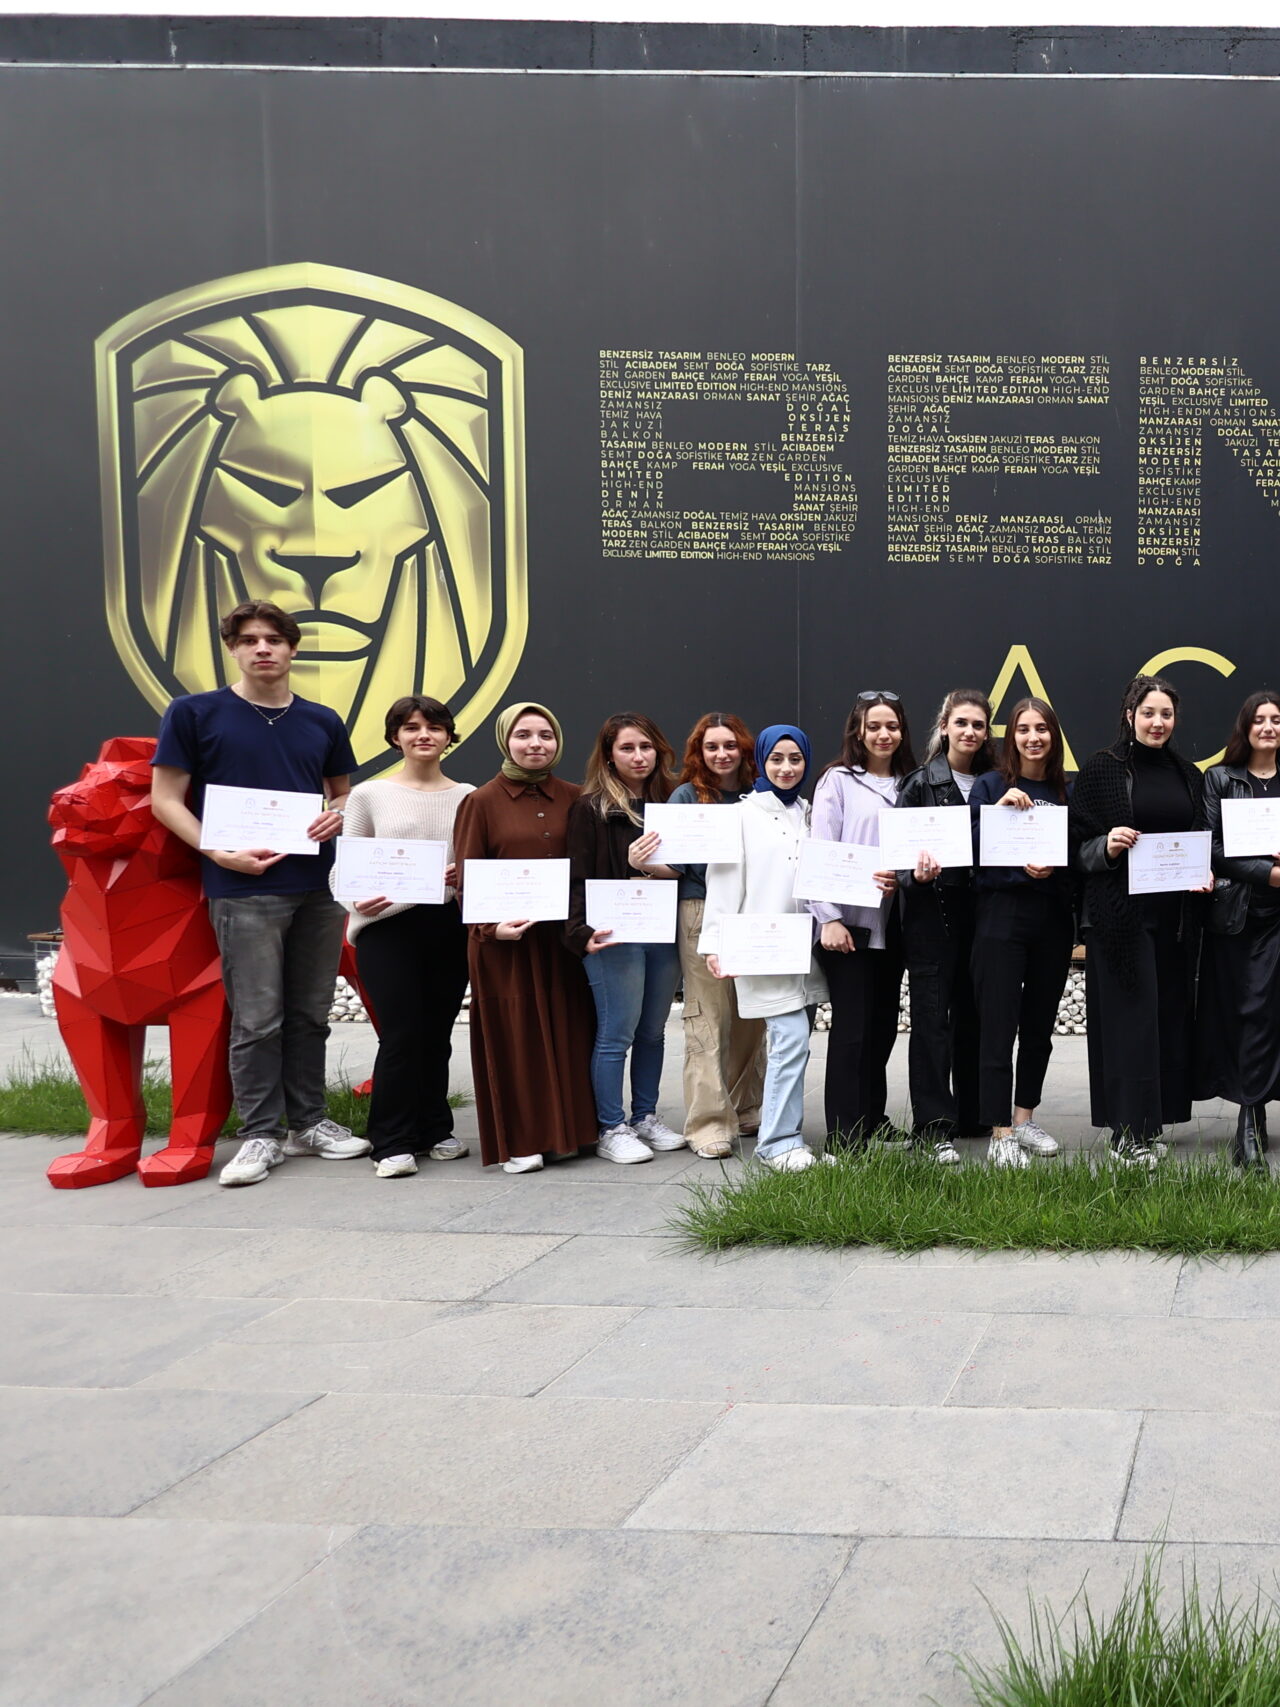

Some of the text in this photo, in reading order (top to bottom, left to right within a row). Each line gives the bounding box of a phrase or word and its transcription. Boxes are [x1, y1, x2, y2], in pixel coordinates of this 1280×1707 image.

[600, 349, 653, 358] BENZERSİZ
[888, 353, 942, 362] BENZERSİZ
[1090, 354, 1109, 364] STİL
[600, 359, 618, 368] STİL
[716, 361, 744, 370] DOĞA
[751, 361, 799, 371] SOFİSTİKE
[1227, 366, 1245, 376] STİL
[936, 375, 968, 385] BAHÇE
[1083, 374, 1109, 386] YEŞİL
[1171, 376, 1199, 385] DOĞA
[1206, 376, 1252, 386] SOFİSTİKE
[943, 394, 972, 403] DENİZ
[888, 443, 940, 453] BENZERSİZ
[1081, 444, 1100, 454] STİL
[1139, 446, 1201, 455] BENZERSİZ
[1139, 477, 1171, 487] BAHÇE
[1182, 546, 1200, 556] STİL
